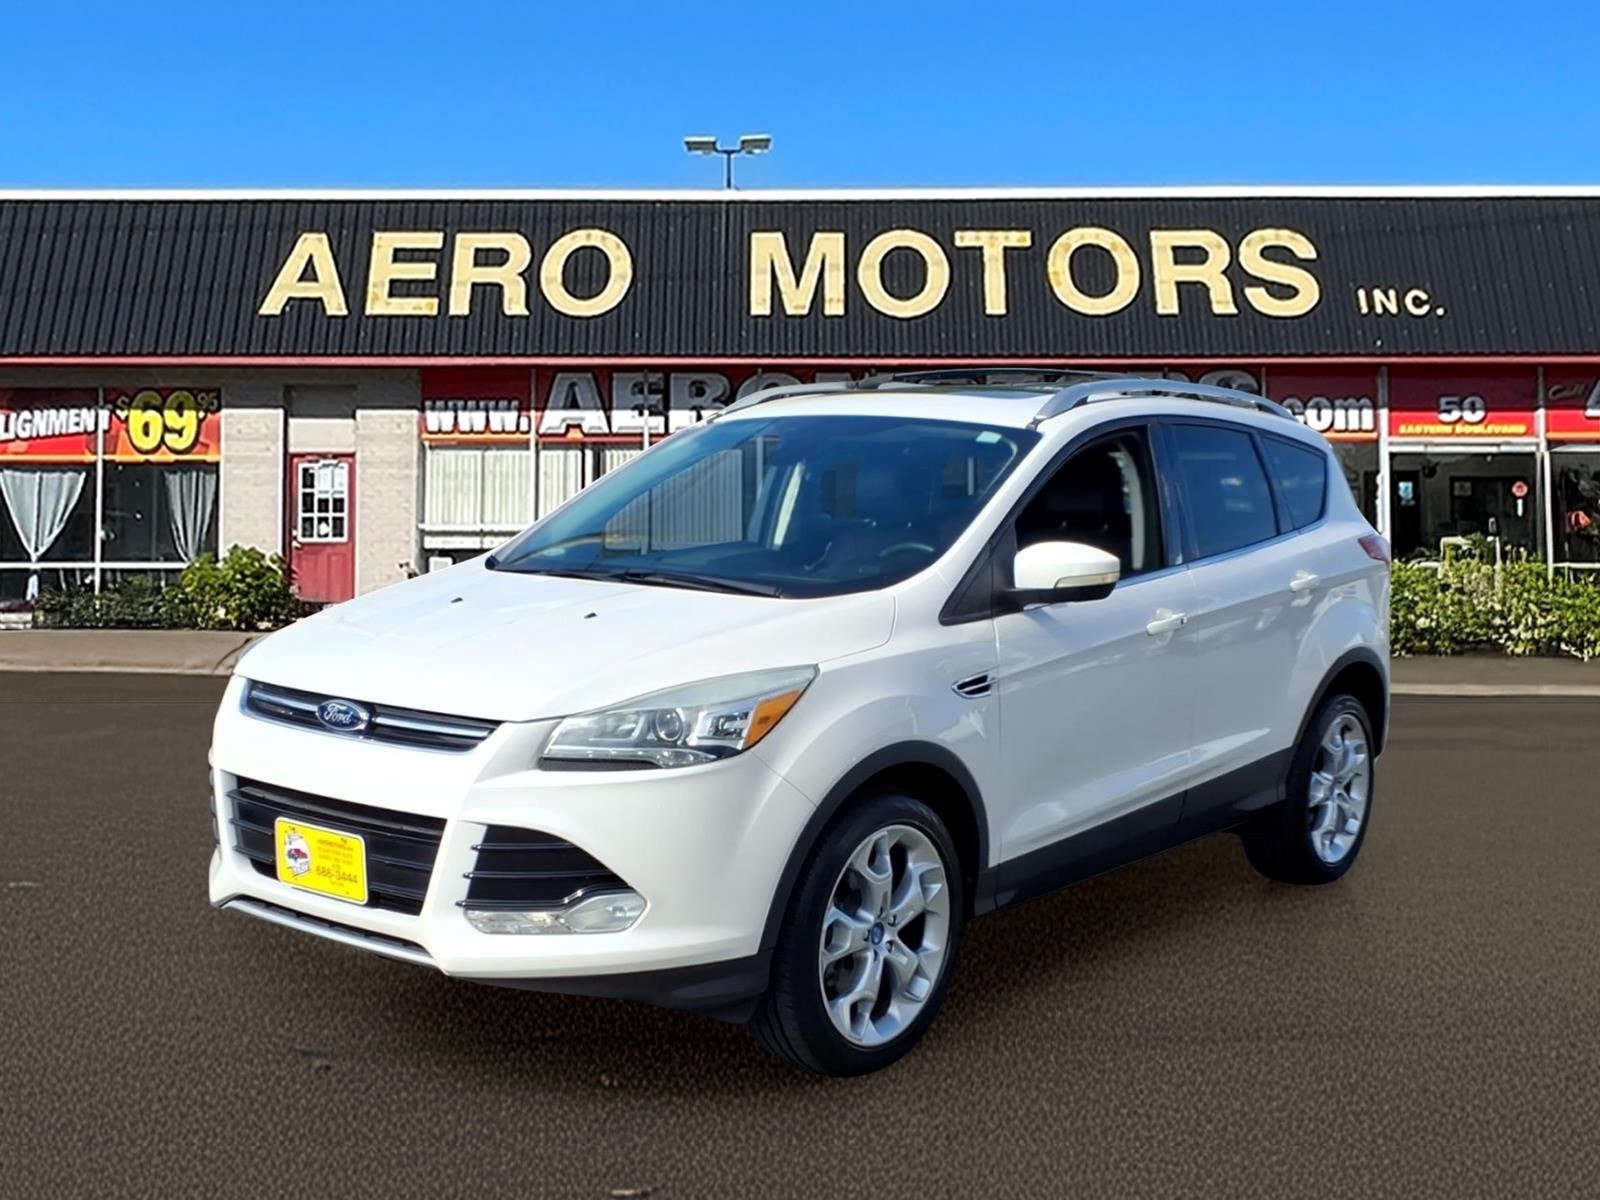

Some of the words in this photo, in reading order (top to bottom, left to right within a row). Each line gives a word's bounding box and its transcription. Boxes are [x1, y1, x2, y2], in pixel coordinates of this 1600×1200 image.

[258, 228, 634, 318] AERO
[750, 226, 1320, 318] MOTORS
[1356, 287, 1446, 318] INC.
[1437, 396, 1486, 423] 50
[324, 703, 353, 724] Ford
